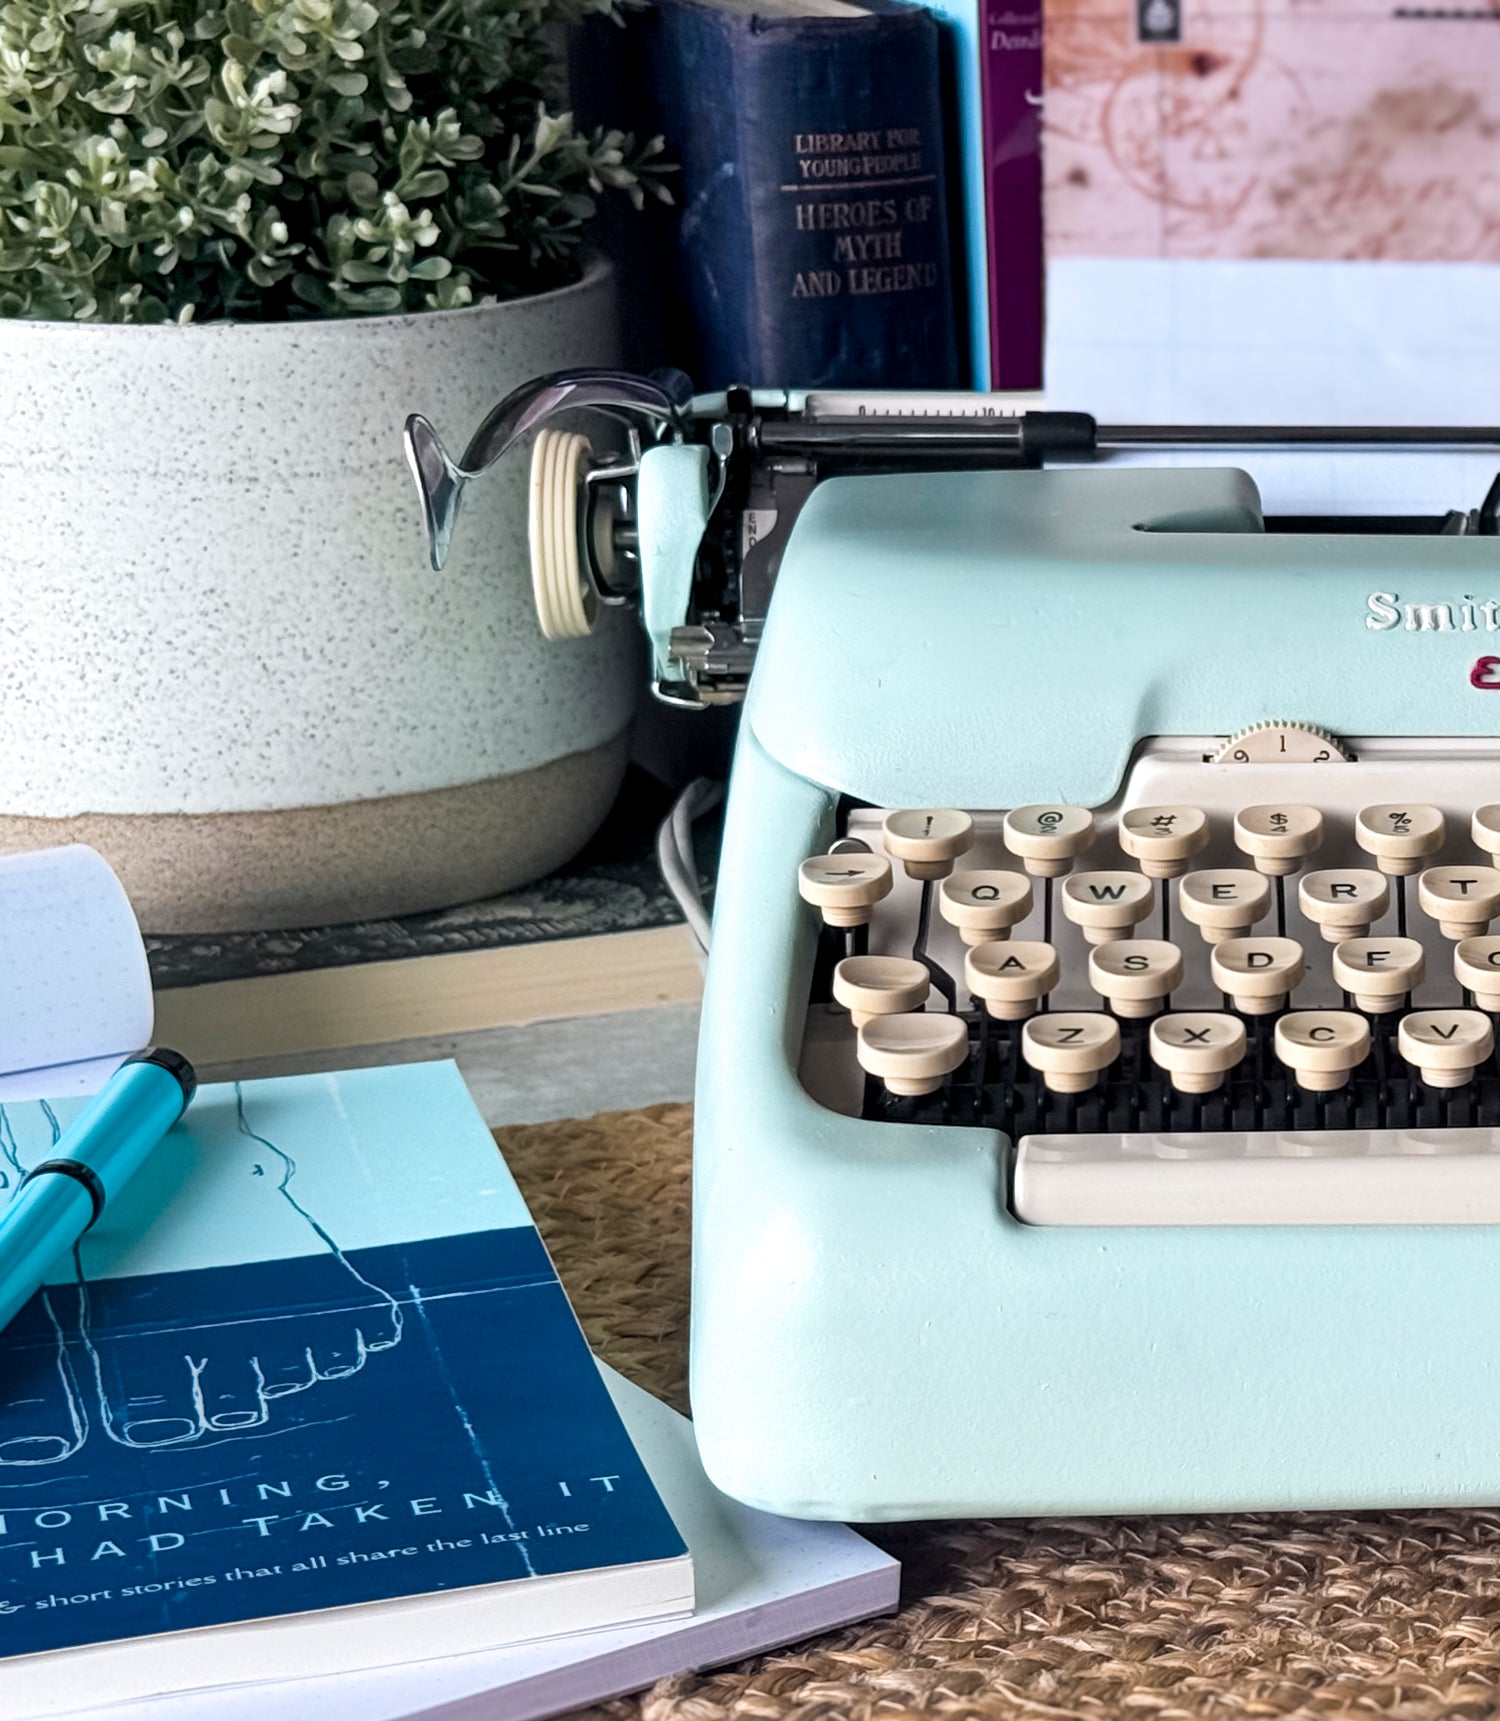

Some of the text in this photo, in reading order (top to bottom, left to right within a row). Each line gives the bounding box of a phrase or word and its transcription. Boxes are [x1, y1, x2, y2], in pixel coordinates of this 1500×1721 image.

[795, 128, 921, 154] LIBRARY FOR
[799, 152, 921, 178] YOUNG PEOPLE
[796, 196, 932, 230] HEROES OF
[834, 230, 902, 262] MYTH
[792, 263, 937, 298] AND LEGEND
[1279, 735, 1287, 752] 1
[1037, 811, 1063, 825] @
[1150, 814, 1177, 826] #
[1269, 813, 1288, 825] $
[1388, 812, 1412, 825] %
[971, 885, 1000, 900] Q
[1089, 885, 1126, 900] W
[1212, 885, 1238, 899] E
[1331, 884, 1357, 898] R
[1449, 879, 1478, 894] T
[998, 956, 1026, 971] A
[1124, 956, 1149, 970] S
[1248, 953, 1273, 967] D
[1367, 951, 1390, 966] F
[1057, 1028, 1084, 1043] Z
[1183, 1028, 1211, 1043] X
[1309, 1027, 1335, 1042] C
[1430, 1024, 1459, 1039] V
[0, 1475, 390, 1534] ORNING,
[30, 1475, 620, 1568] HAD TAKEN IT
[36, 1589, 112, 1610] short
[122, 1575, 217, 1597] stories
[225, 1564, 282, 1582] that
[292, 1555, 327, 1572] all
[337, 1546, 418, 1566] share
[427, 1538, 472, 1552] the
[480, 1529, 530, 1545] last
[537, 1523, 591, 1537] line
